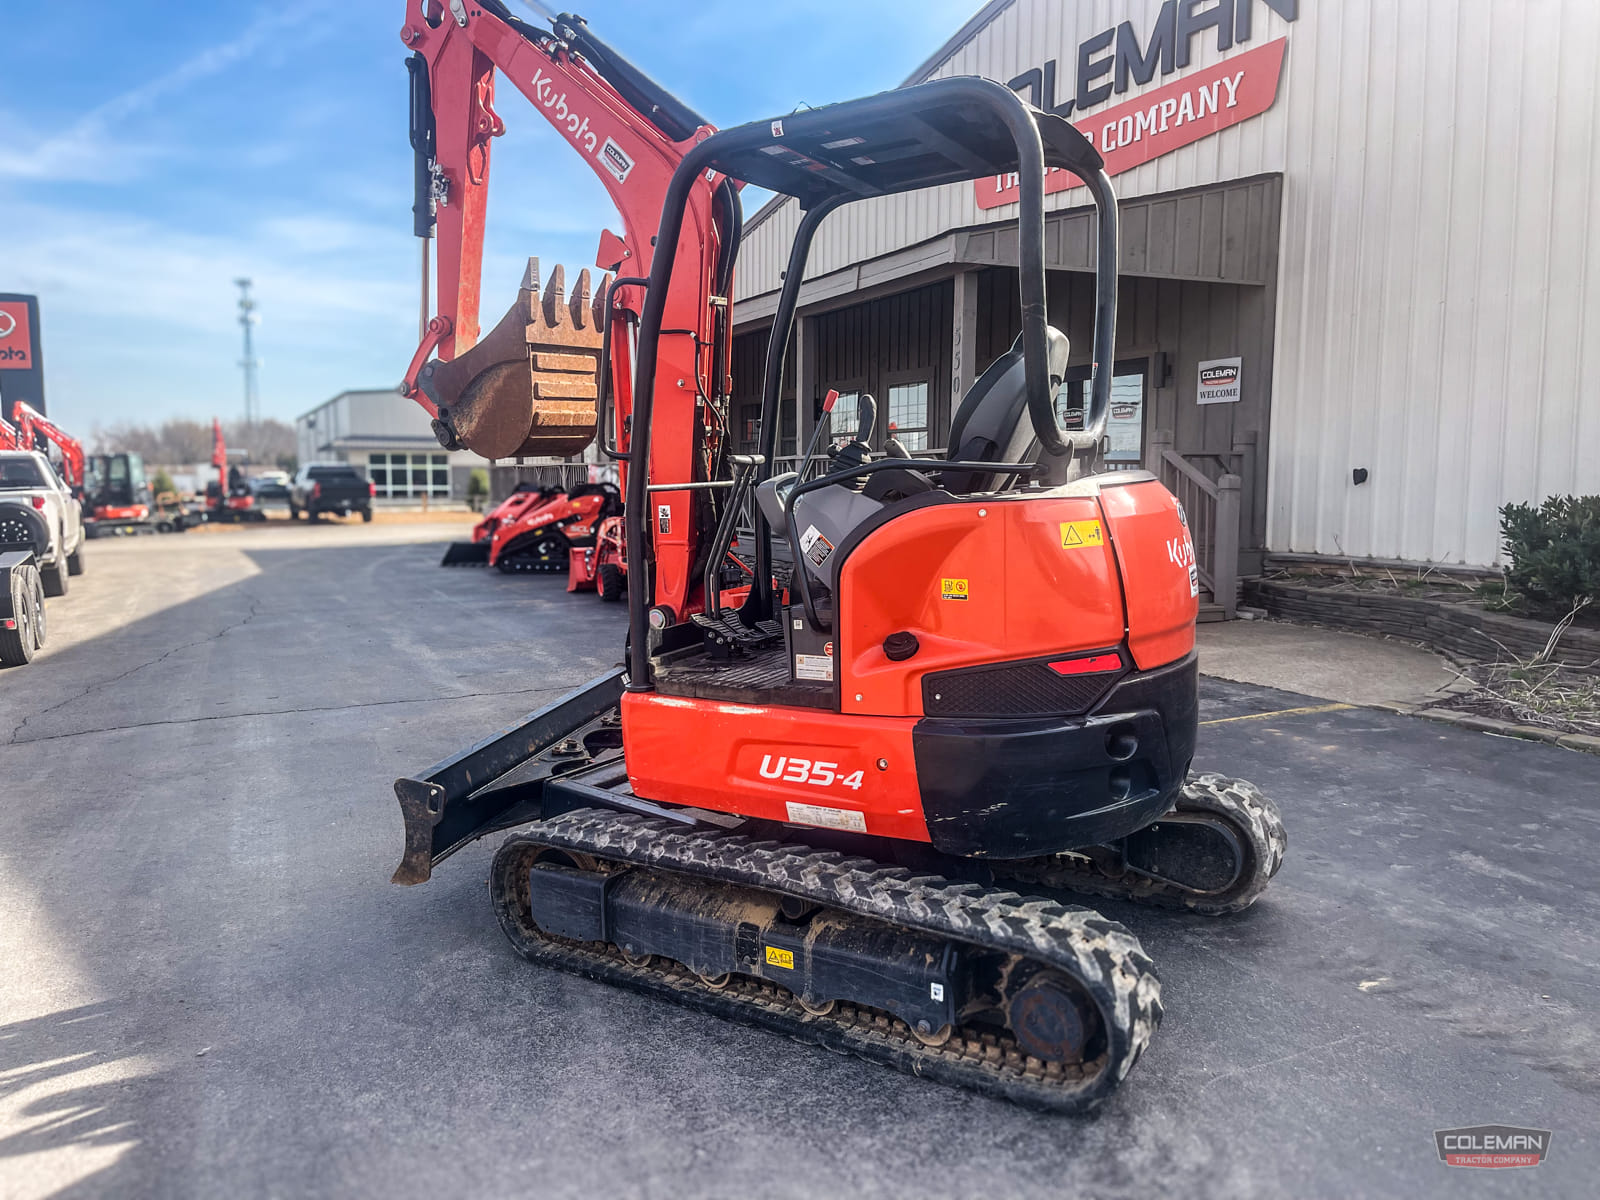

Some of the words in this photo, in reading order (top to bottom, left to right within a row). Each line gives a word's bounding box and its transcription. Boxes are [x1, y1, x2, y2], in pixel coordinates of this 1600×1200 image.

[531, 68, 598, 153] Kubota
[1101, 71, 1246, 153] COMPANY
[1202, 368, 1237, 379] COLEMAN
[1200, 388, 1238, 399] WELCOME
[759, 754, 865, 790] U35-4
